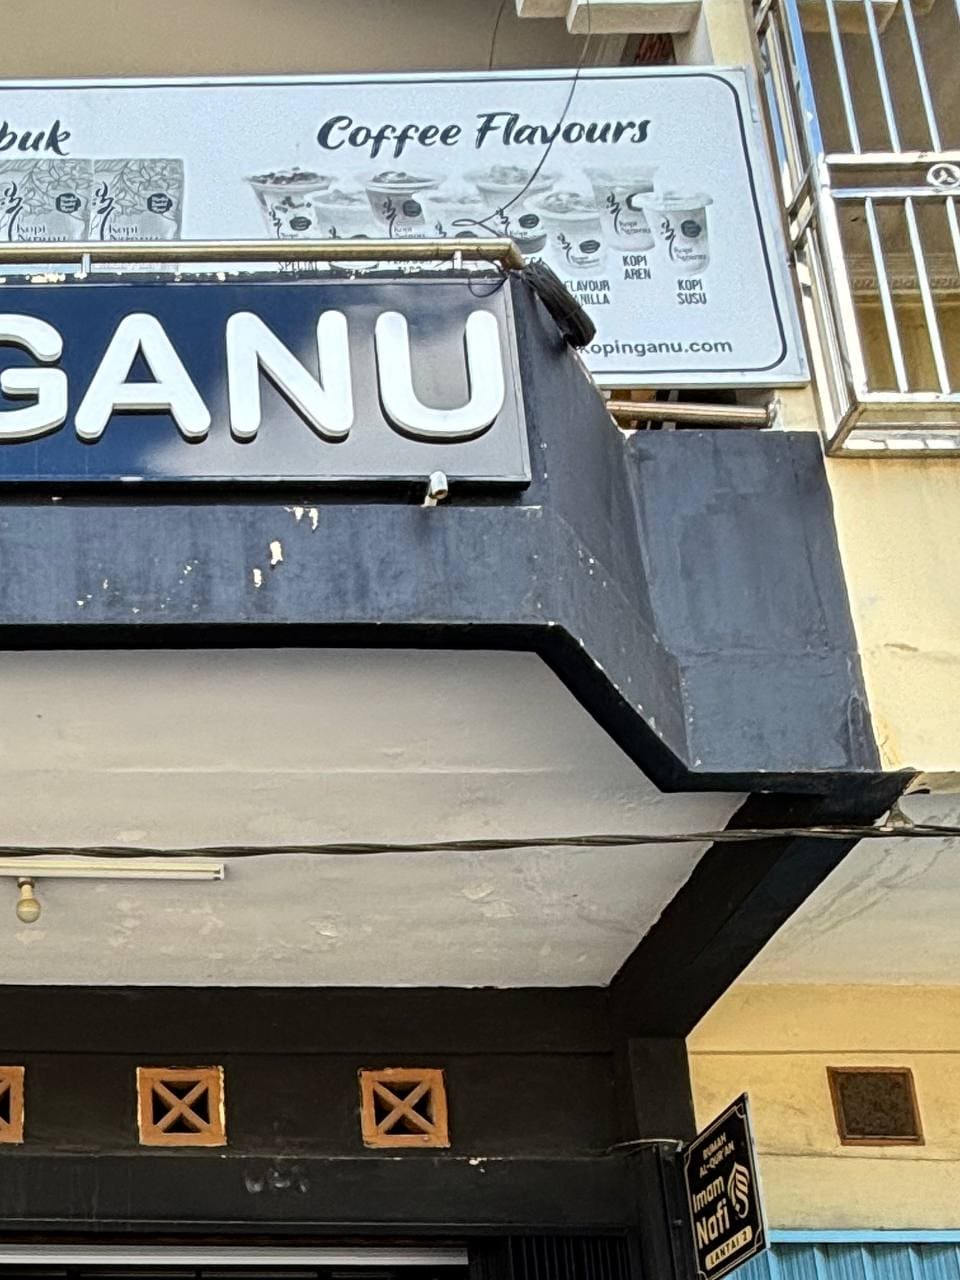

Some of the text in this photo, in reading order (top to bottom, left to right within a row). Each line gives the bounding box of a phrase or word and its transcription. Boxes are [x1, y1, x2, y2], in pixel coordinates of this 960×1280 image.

[316, 111, 651, 159] Coffee Flavours
[622, 256, 647, 267] KOPI
[624, 268, 651, 280] AREN
[677, 279, 703, 291] KOPI
[576, 293, 610, 304] NILLA
[677, 293, 707, 305] SUSU
[692, 1176, 725, 1214] Imam
[709, 1234, 739, 1266] LANTAI
